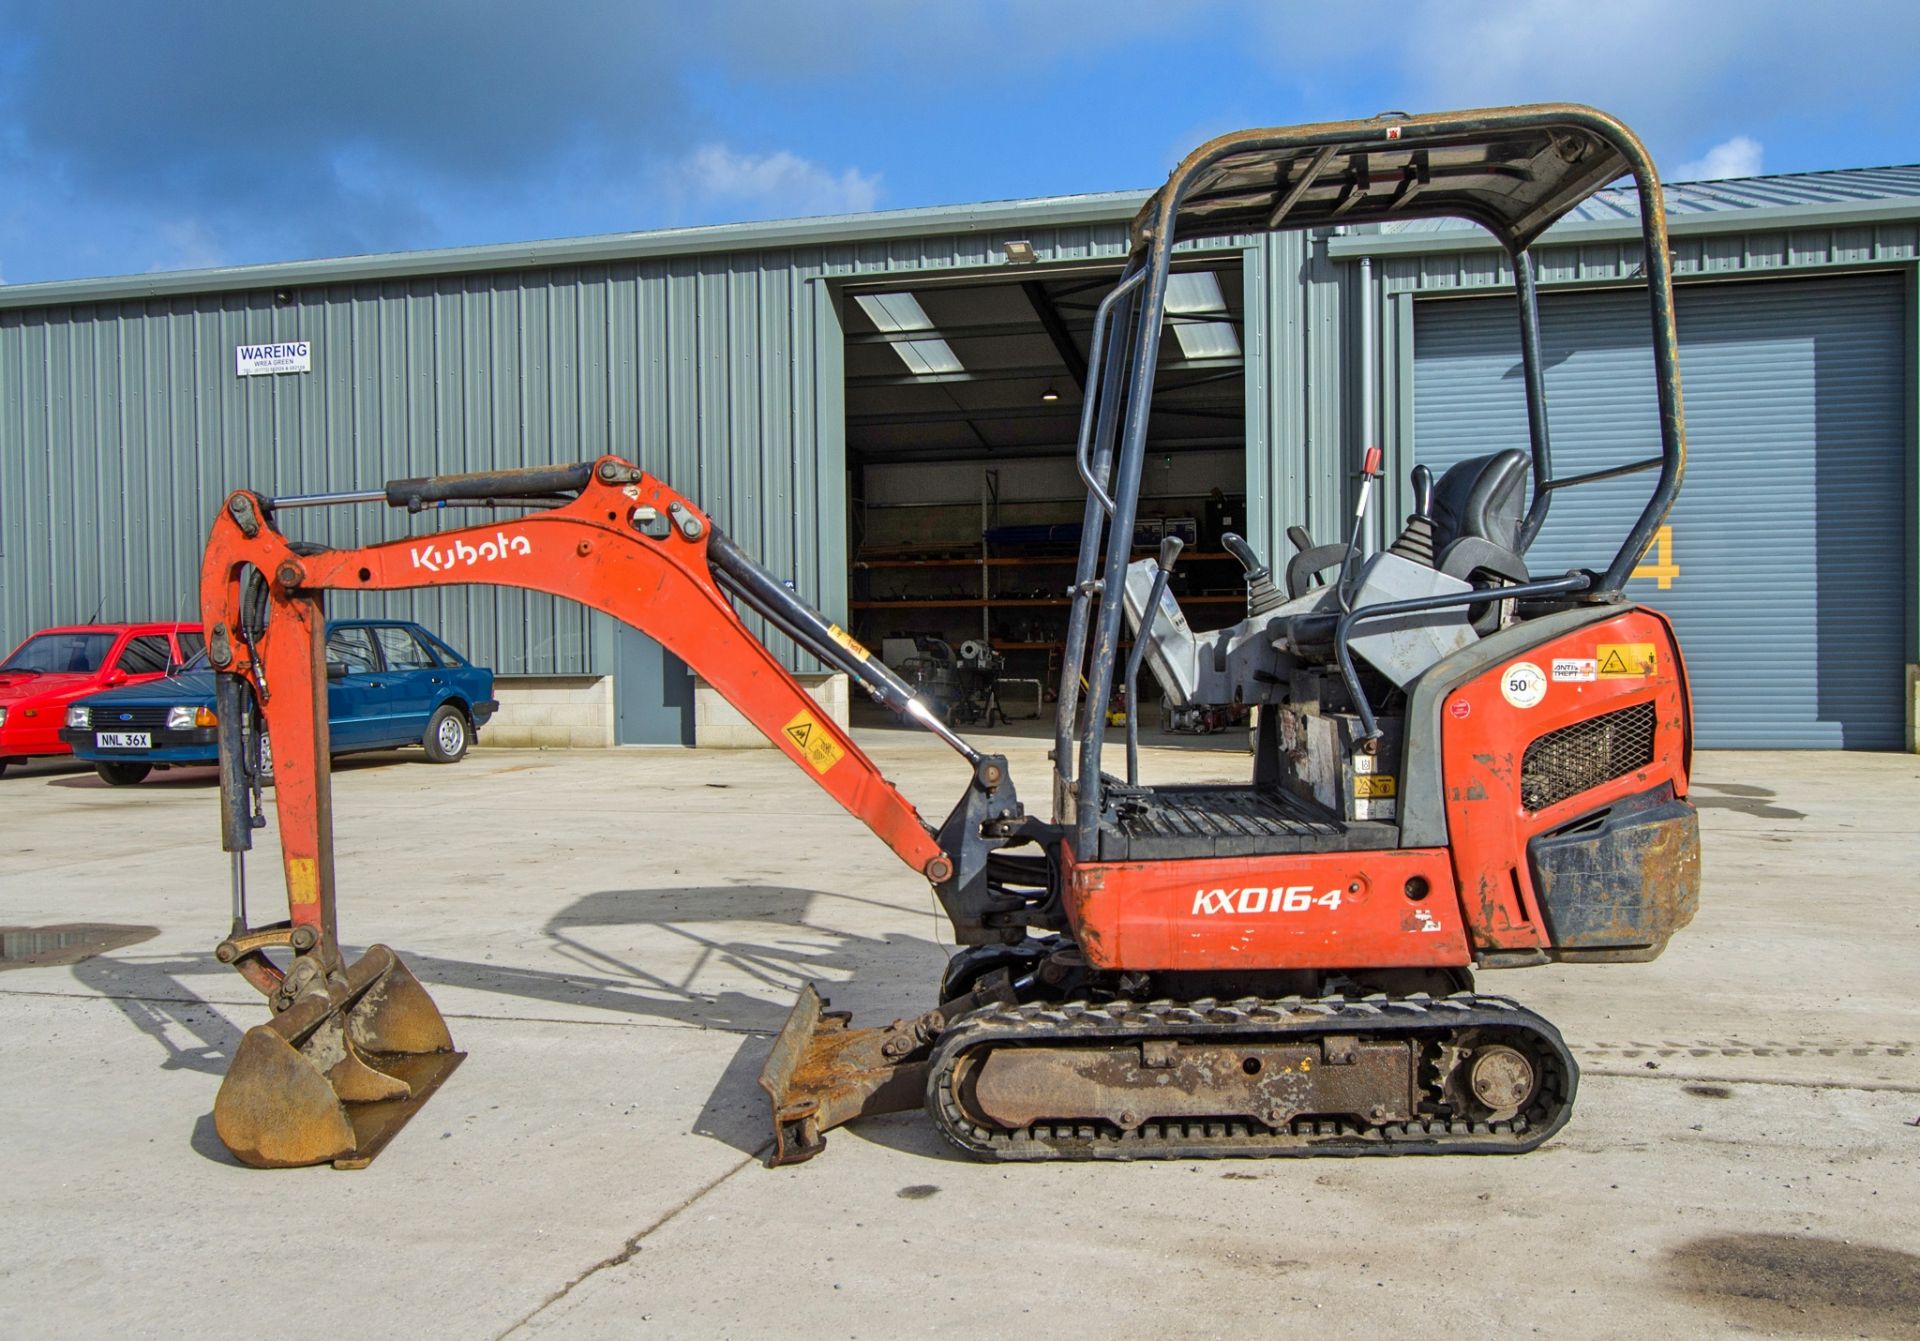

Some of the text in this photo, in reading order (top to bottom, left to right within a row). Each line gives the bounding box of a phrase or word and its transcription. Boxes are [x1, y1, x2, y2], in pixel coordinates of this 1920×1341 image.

[241, 344, 307, 360] WAREING
[411, 532, 531, 571] Kubota
[1630, 526, 1680, 589] 4
[102, 735, 147, 745] NNL 36X
[1192, 886, 1342, 915] KX016-4
